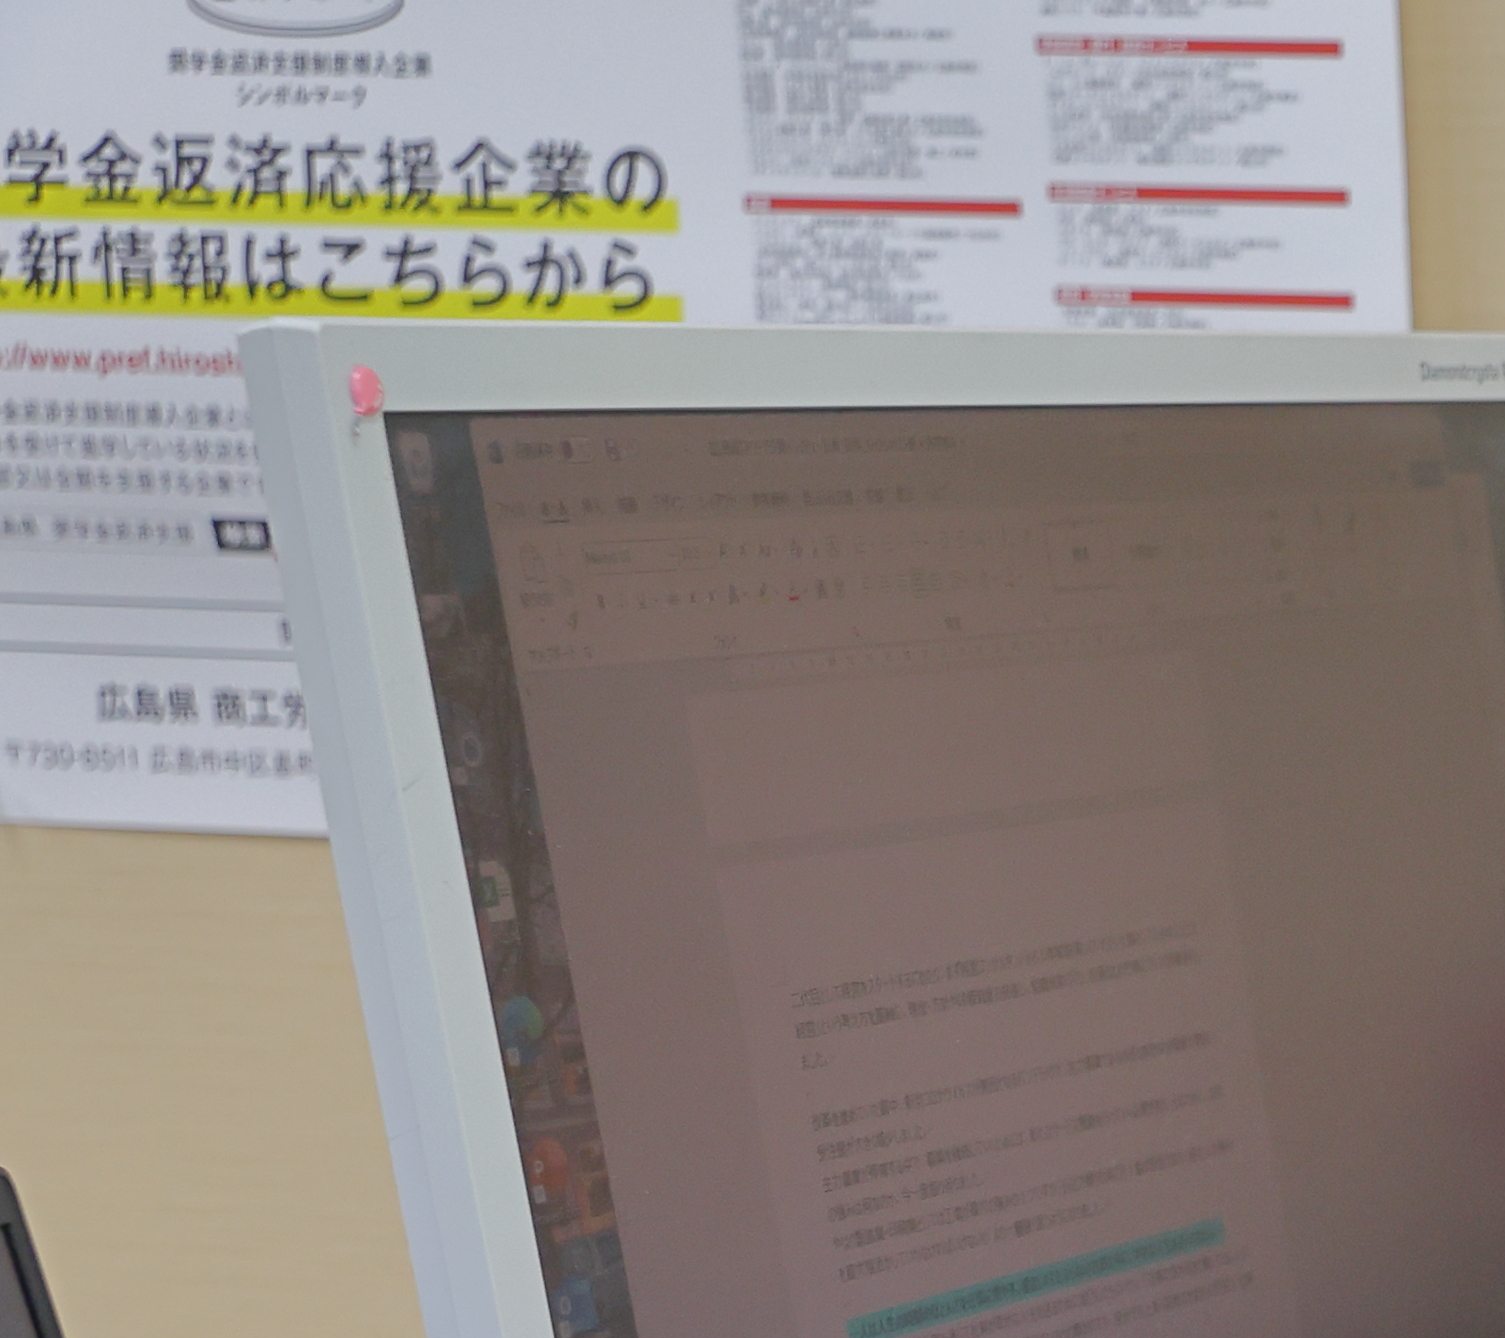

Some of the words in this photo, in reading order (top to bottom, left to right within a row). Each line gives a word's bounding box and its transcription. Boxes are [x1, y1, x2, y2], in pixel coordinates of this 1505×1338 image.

[4, 129, 669, 218] 学金返済応援企業の
[0, 223, 654, 313] 新情報はこちらから
